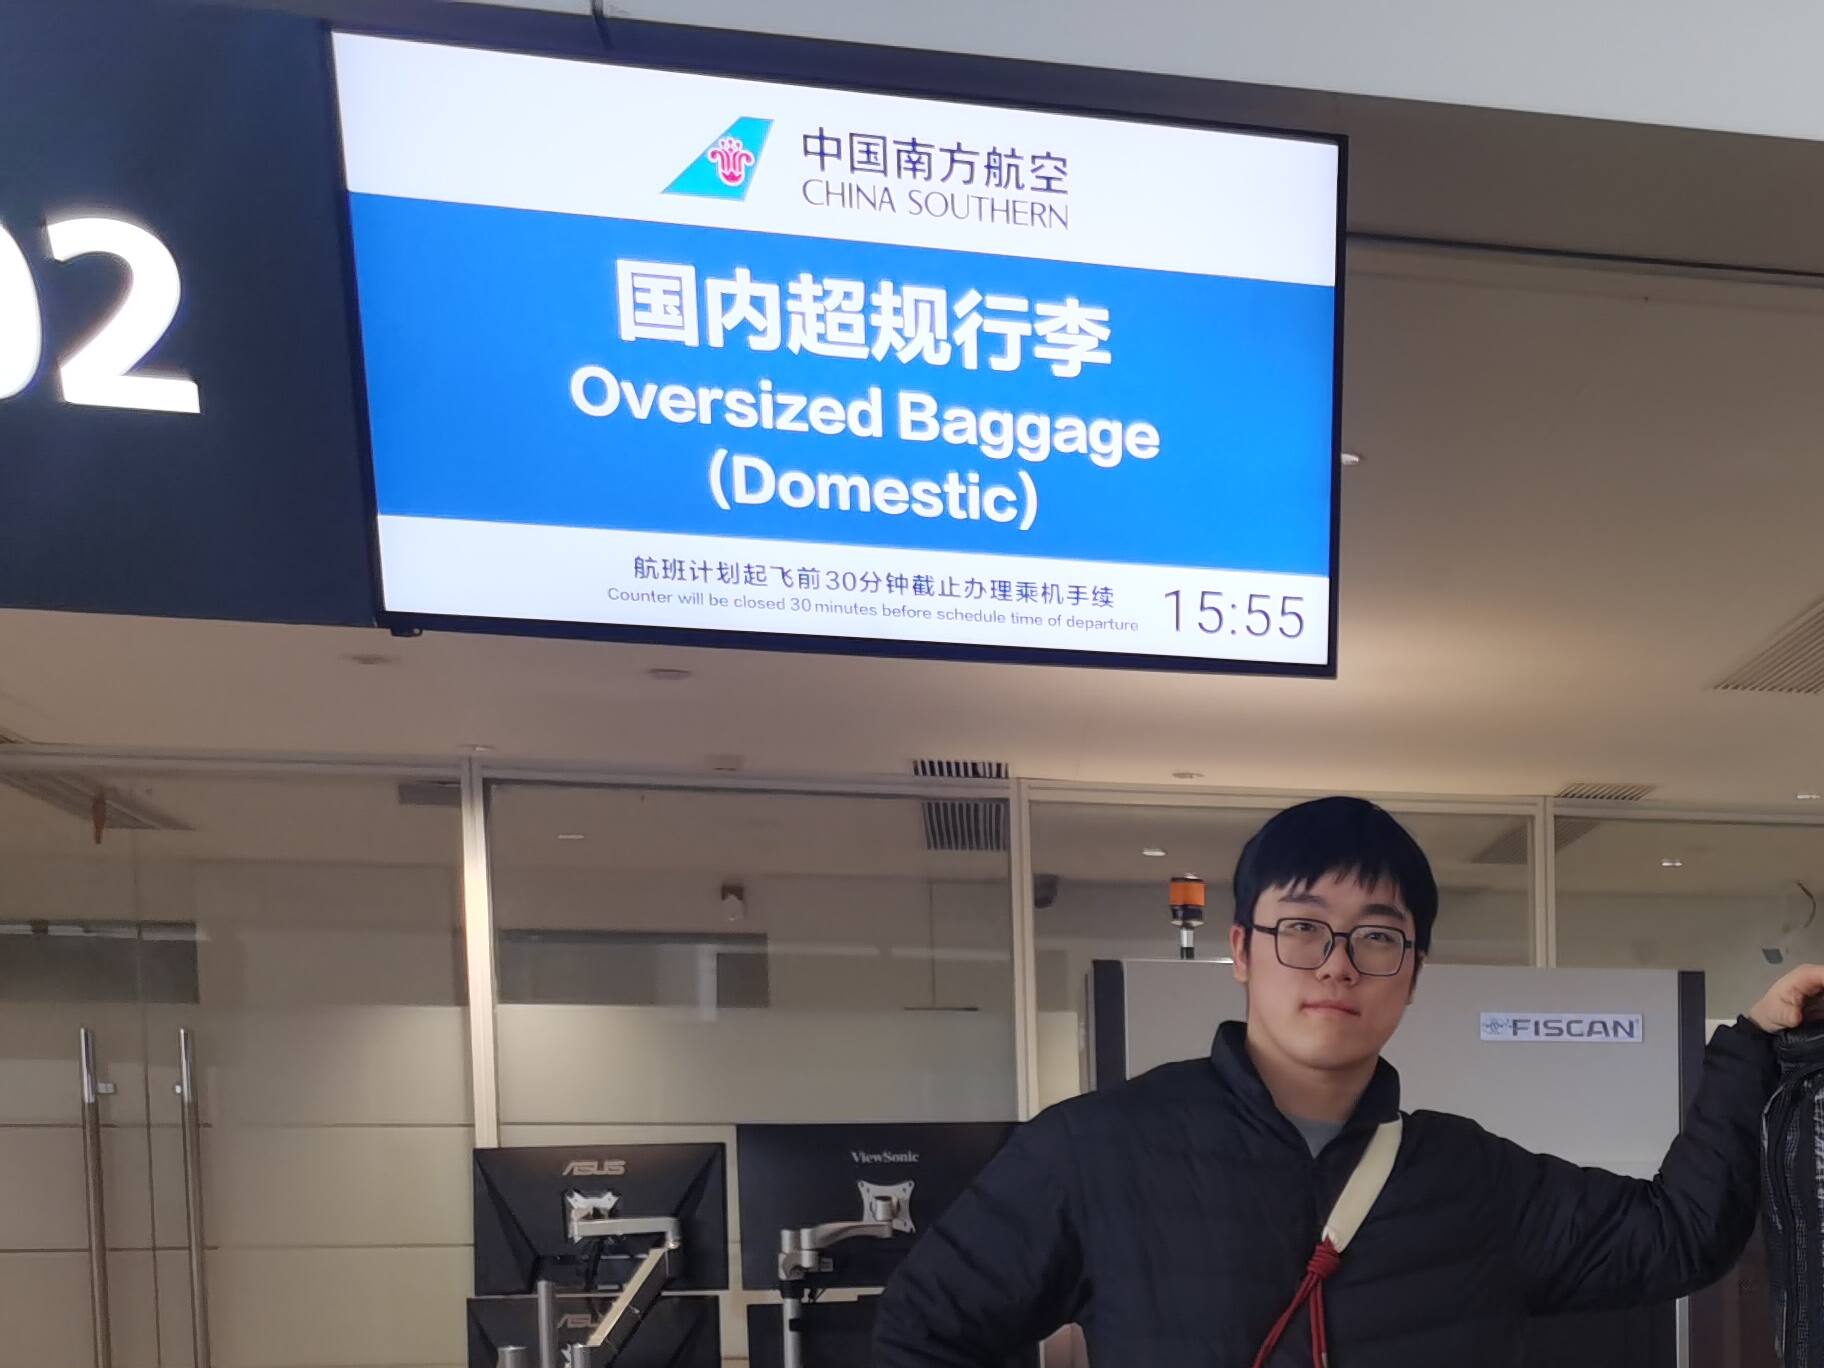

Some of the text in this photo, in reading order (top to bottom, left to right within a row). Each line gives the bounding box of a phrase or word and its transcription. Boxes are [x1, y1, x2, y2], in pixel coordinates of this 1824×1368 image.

[802, 127, 1069, 194] 中国南方航空
[802, 178, 1069, 230] CHINA SOUTHERN
[615, 259, 1112, 378] 国内超规行李
[569, 365, 1161, 468] Oversized Baggage
[708, 448, 1039, 531] (Domestic)
[633, 555, 1115, 609] 航班计划起飞前30分钟截止办理乘机手续
[607, 587, 1139, 632] Counter will be closed 30 minutes before schedule time of departure
[1164, 589, 1305, 638] 15:55
[1512, 1019, 1635, 1038] FISCAN
[562, 1160, 627, 1176] ASUS
[851, 1150, 920, 1163] ViewSonic
[557, 1314, 602, 1329] ASU
